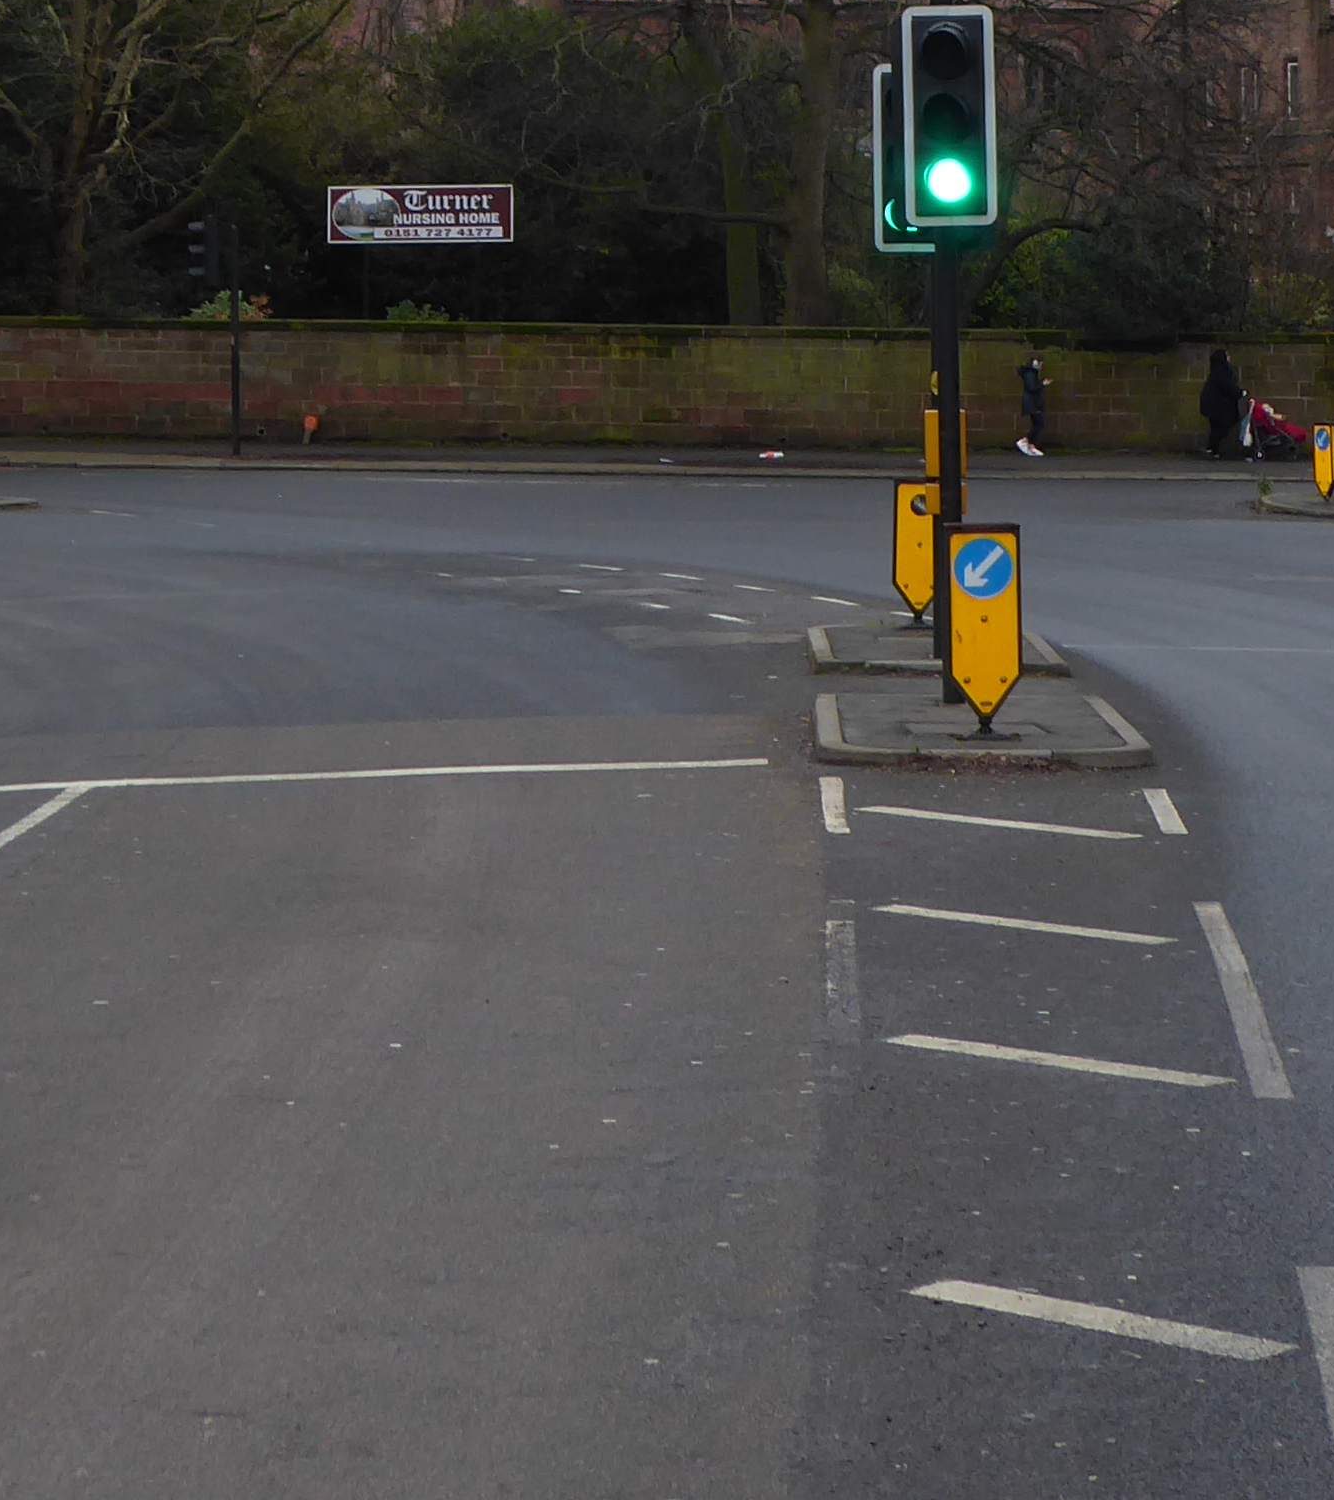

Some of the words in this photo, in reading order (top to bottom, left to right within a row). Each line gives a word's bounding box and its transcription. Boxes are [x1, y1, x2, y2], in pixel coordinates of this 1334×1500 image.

[403, 190, 493, 211] Turner
[393, 212, 455, 225] NURSING
[459, 212, 500, 224] HOME
[384, 228, 420, 237] 0151
[425, 228, 452, 237] 727
[457, 228, 493, 237] 4177
